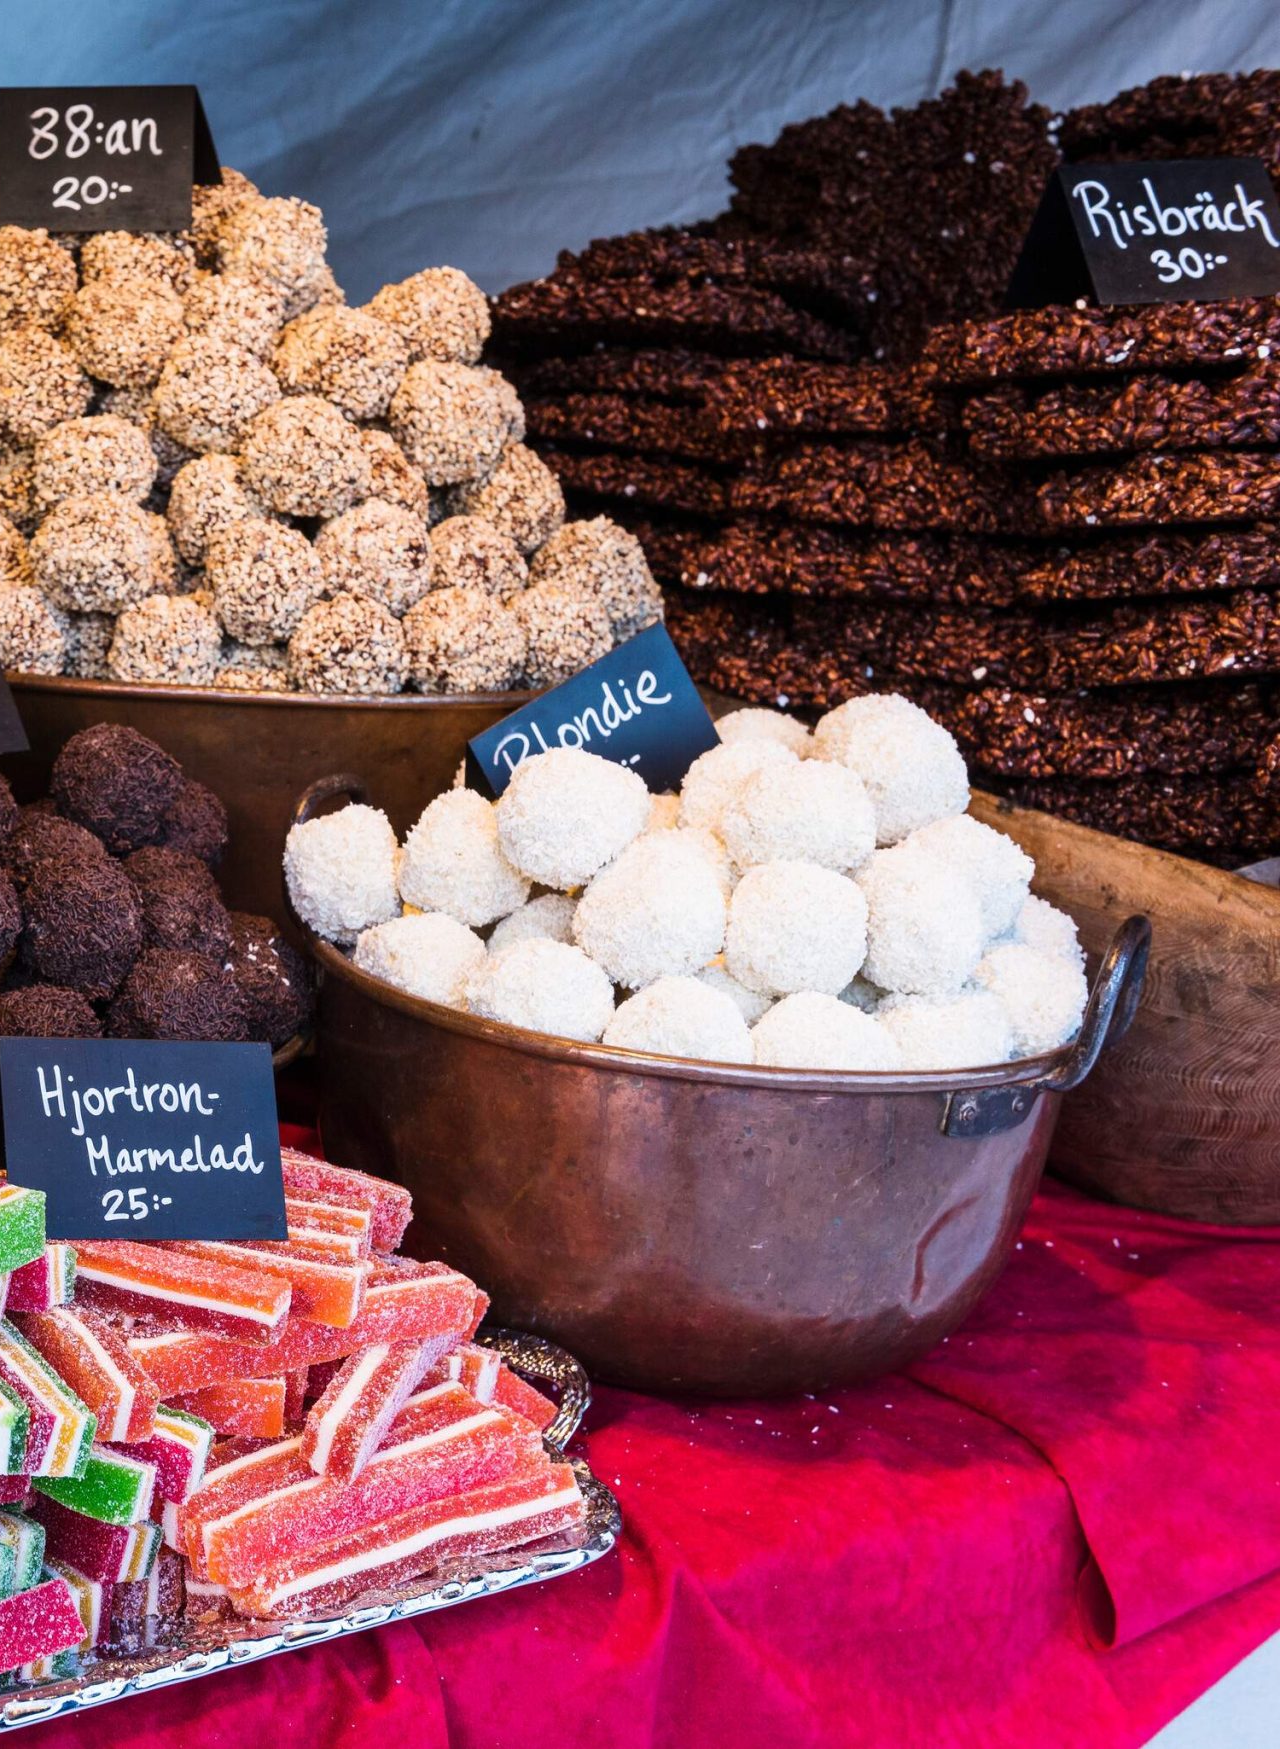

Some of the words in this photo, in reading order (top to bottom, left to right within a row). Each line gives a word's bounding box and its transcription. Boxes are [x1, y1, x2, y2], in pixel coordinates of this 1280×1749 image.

[52, 176, 133, 211] 20:-
[1072, 177, 1280, 249] Risbräck
[1150, 247, 1228, 283] 30:-
[36, 1064, 220, 1137] Hjortron-
[85, 1132, 265, 1177] Marmelad
[101, 1187, 173, 1222] 25:-
